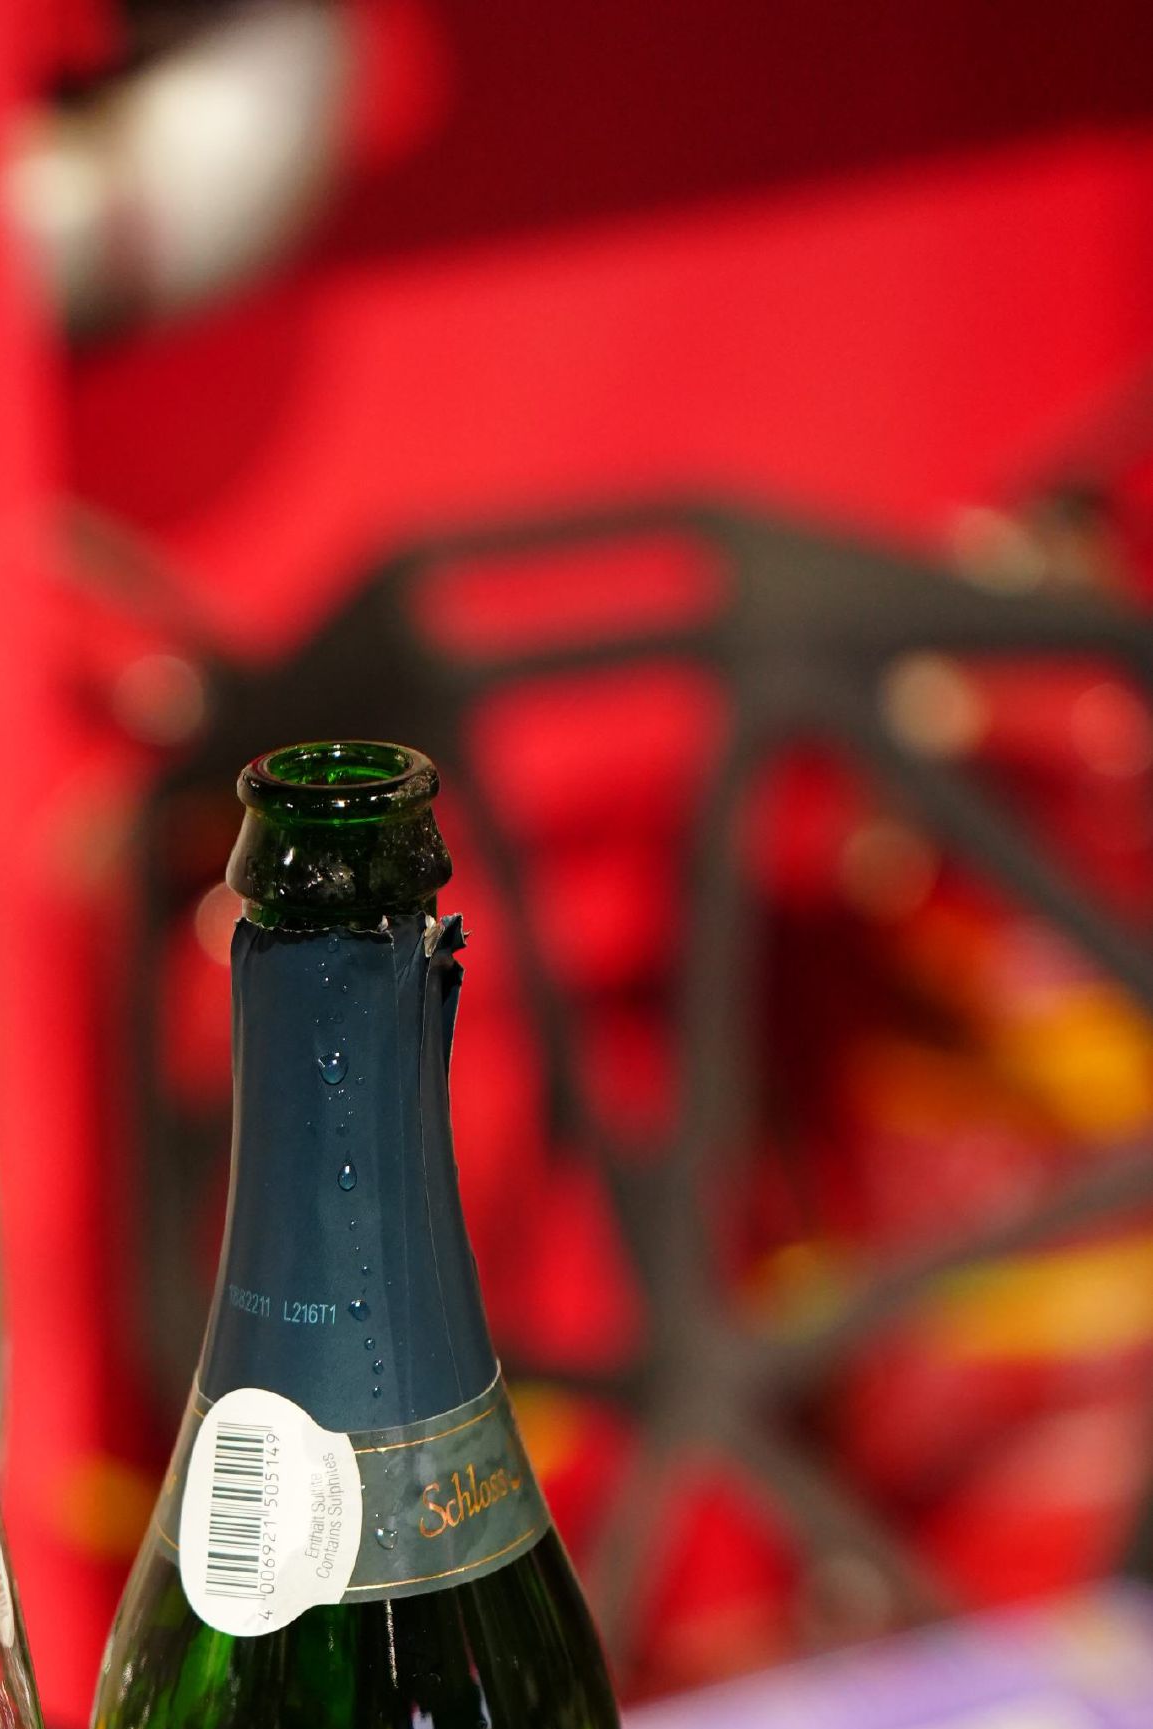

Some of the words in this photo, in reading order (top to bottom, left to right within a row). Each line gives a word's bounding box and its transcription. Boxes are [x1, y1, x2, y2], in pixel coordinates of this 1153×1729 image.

[283, 1300, 337, 1325] L216T1
[264, 1433, 281, 1508] 505149
[322, 1452, 344, 1517] Sulphites
[260, 1520, 277, 1595] 006921
[315, 1520, 342, 1580] Contains
